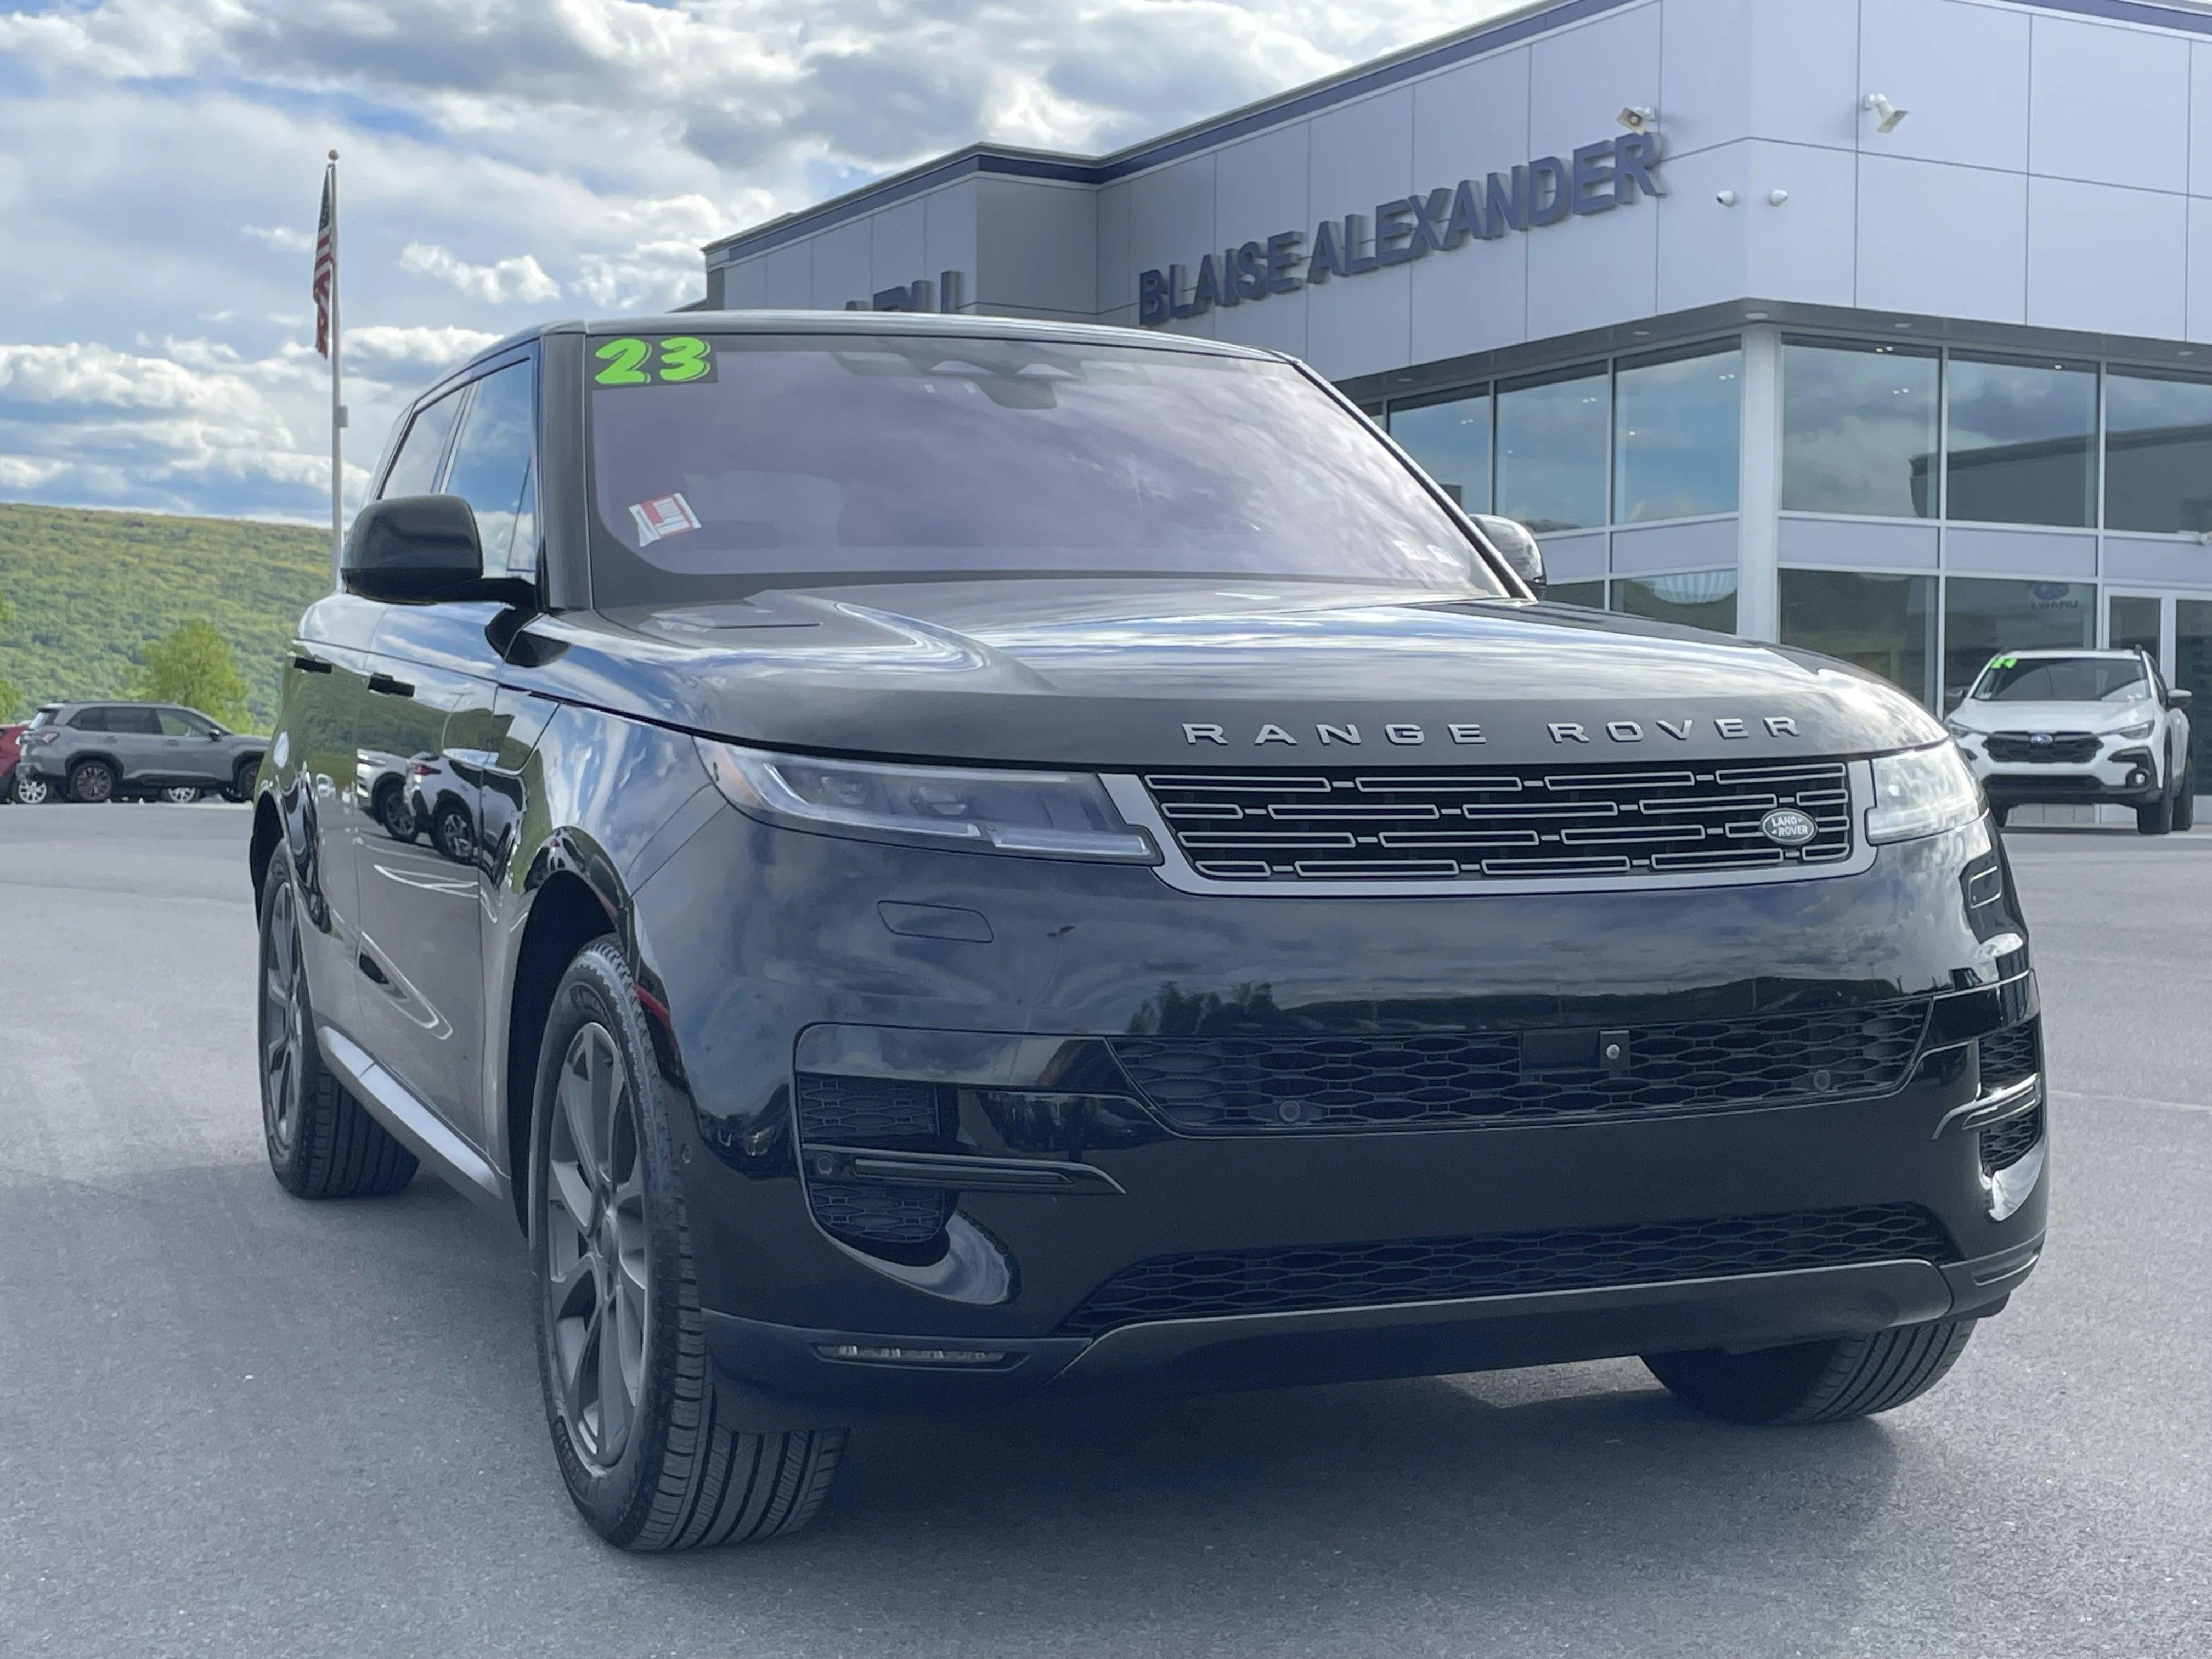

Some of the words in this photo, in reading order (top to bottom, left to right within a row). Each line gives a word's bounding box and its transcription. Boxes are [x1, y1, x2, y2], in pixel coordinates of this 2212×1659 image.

[1139, 230, 1304, 325] BLAISE
[1306, 132, 1667, 284] ALEXANDER
[595, 336, 710, 383] 23
[1182, 723, 1487, 746] RANGE
[1547, 716, 1801, 743] ROVER
[1771, 815, 1798, 827] LAND
[1778, 825, 1808, 837] ROVER
